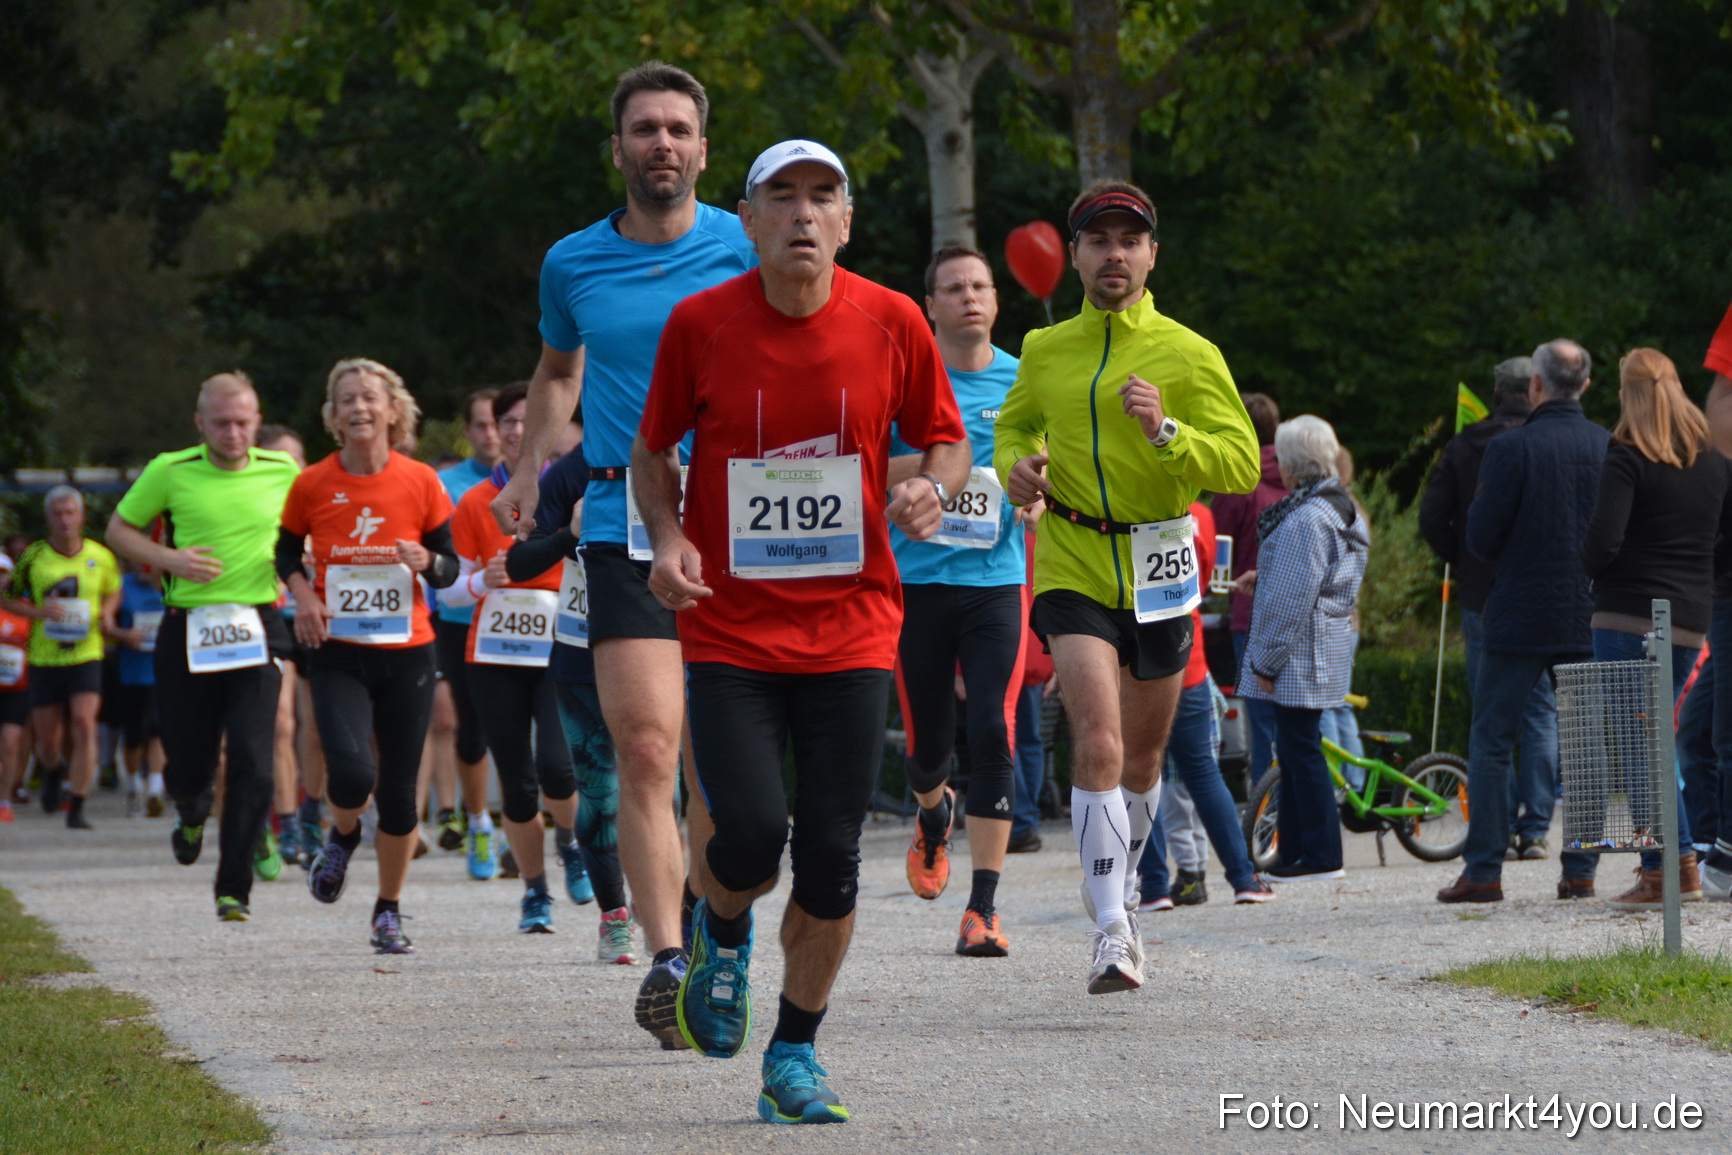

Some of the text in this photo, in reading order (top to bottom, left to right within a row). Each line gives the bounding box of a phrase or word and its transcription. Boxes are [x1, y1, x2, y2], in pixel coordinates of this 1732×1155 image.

[779, 470, 823, 480] BOCK
[749, 495, 842, 531] 2192
[943, 521, 968, 532] David
[330, 545, 397, 557] funrunners
[766, 544, 827, 559] Wolfgang
[340, 589, 400, 612] 2248
[358, 620, 382, 630] Helga
[490, 611, 547, 636] 2489
[199, 623, 252, 647] 2035
[501, 641, 532, 653] Brigitte
